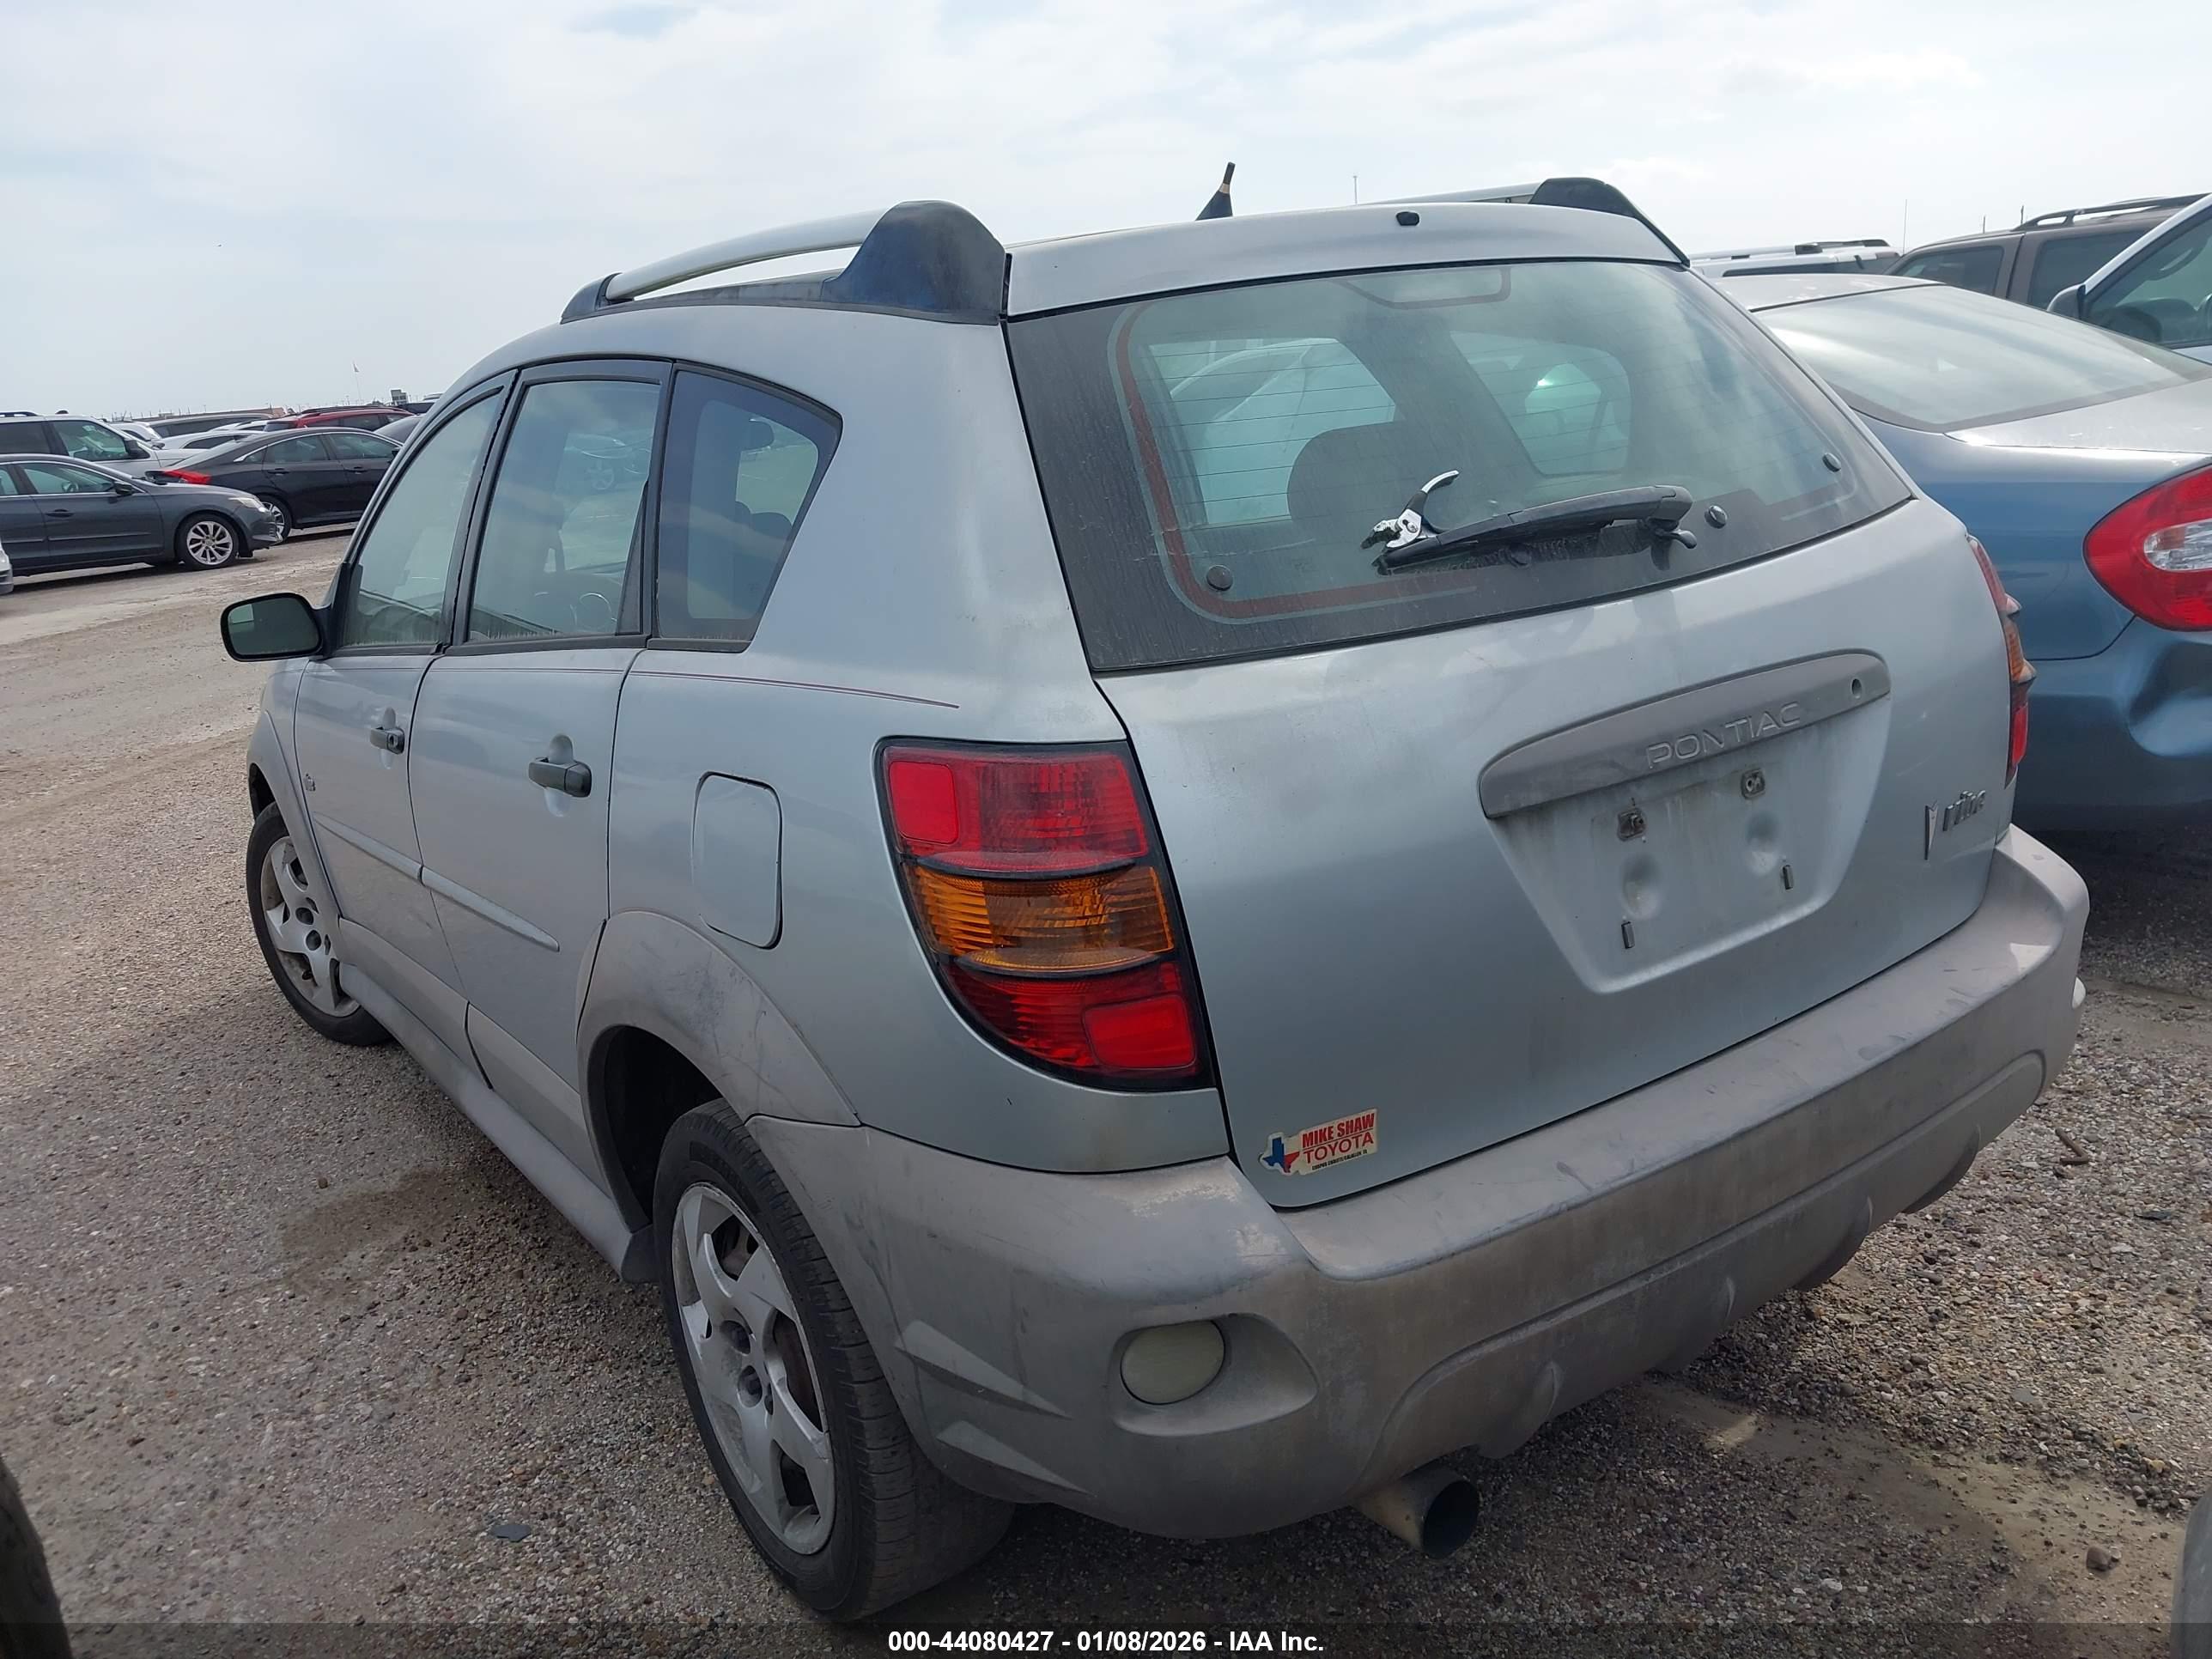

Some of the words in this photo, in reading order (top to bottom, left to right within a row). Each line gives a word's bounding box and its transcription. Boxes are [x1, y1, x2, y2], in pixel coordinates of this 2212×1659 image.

[1647, 701, 1802, 769] PONTIAC
[1302, 1125, 1334, 1149] MIKE
[1337, 1113, 1375, 1138] SHAW
[1304, 1131, 1374, 1164] TOYOTA
